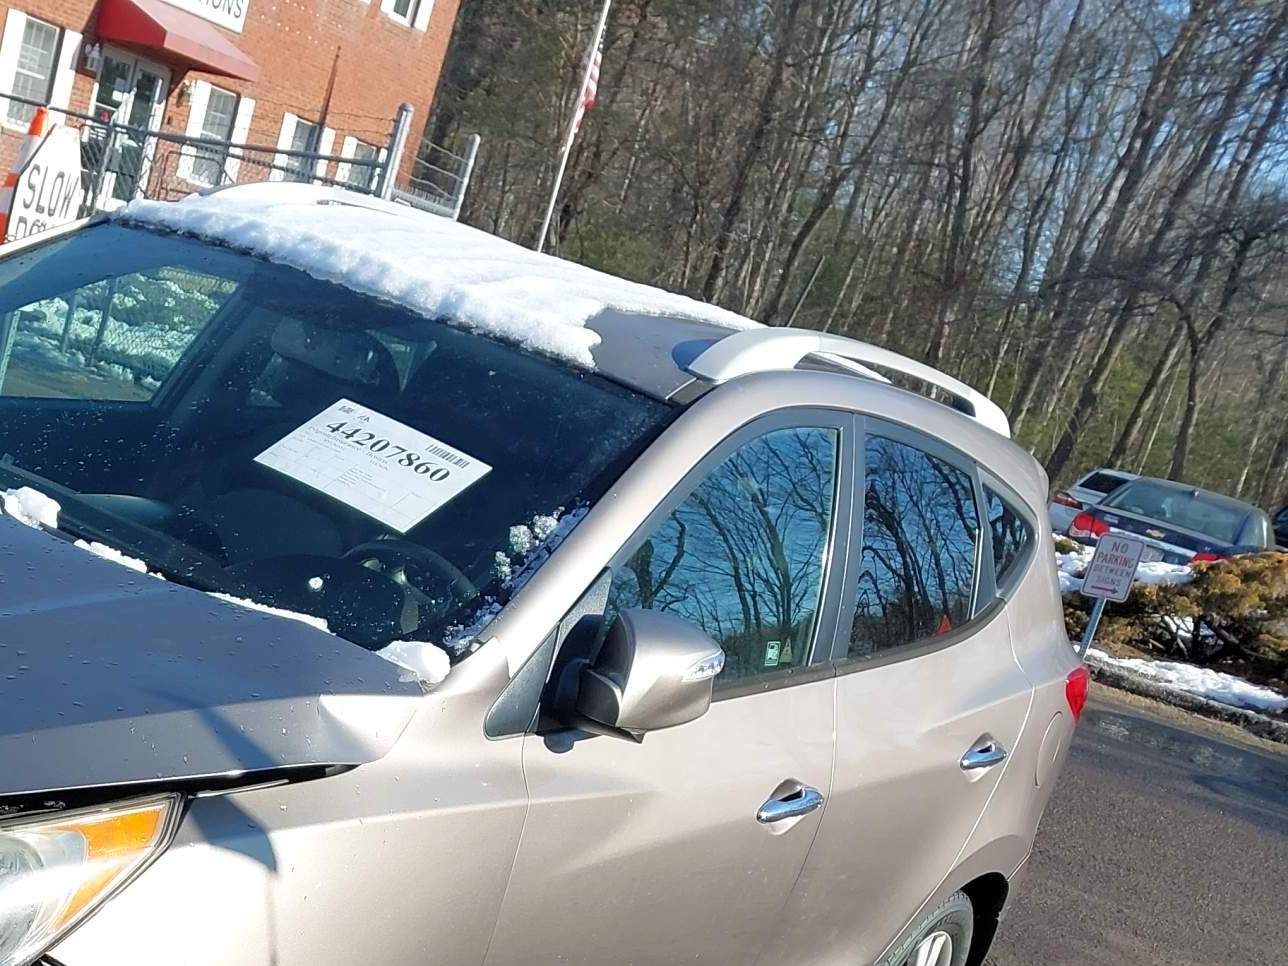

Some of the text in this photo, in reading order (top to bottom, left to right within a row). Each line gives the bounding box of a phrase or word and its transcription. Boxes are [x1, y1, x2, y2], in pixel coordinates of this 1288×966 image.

[22, 163, 80, 220] SLOW
[325, 420, 451, 482] 44207860
[1111, 541, 1129, 554] NO
[1097, 551, 1135, 568] PARKING
[1093, 564, 1131, 579] BETWEEN
